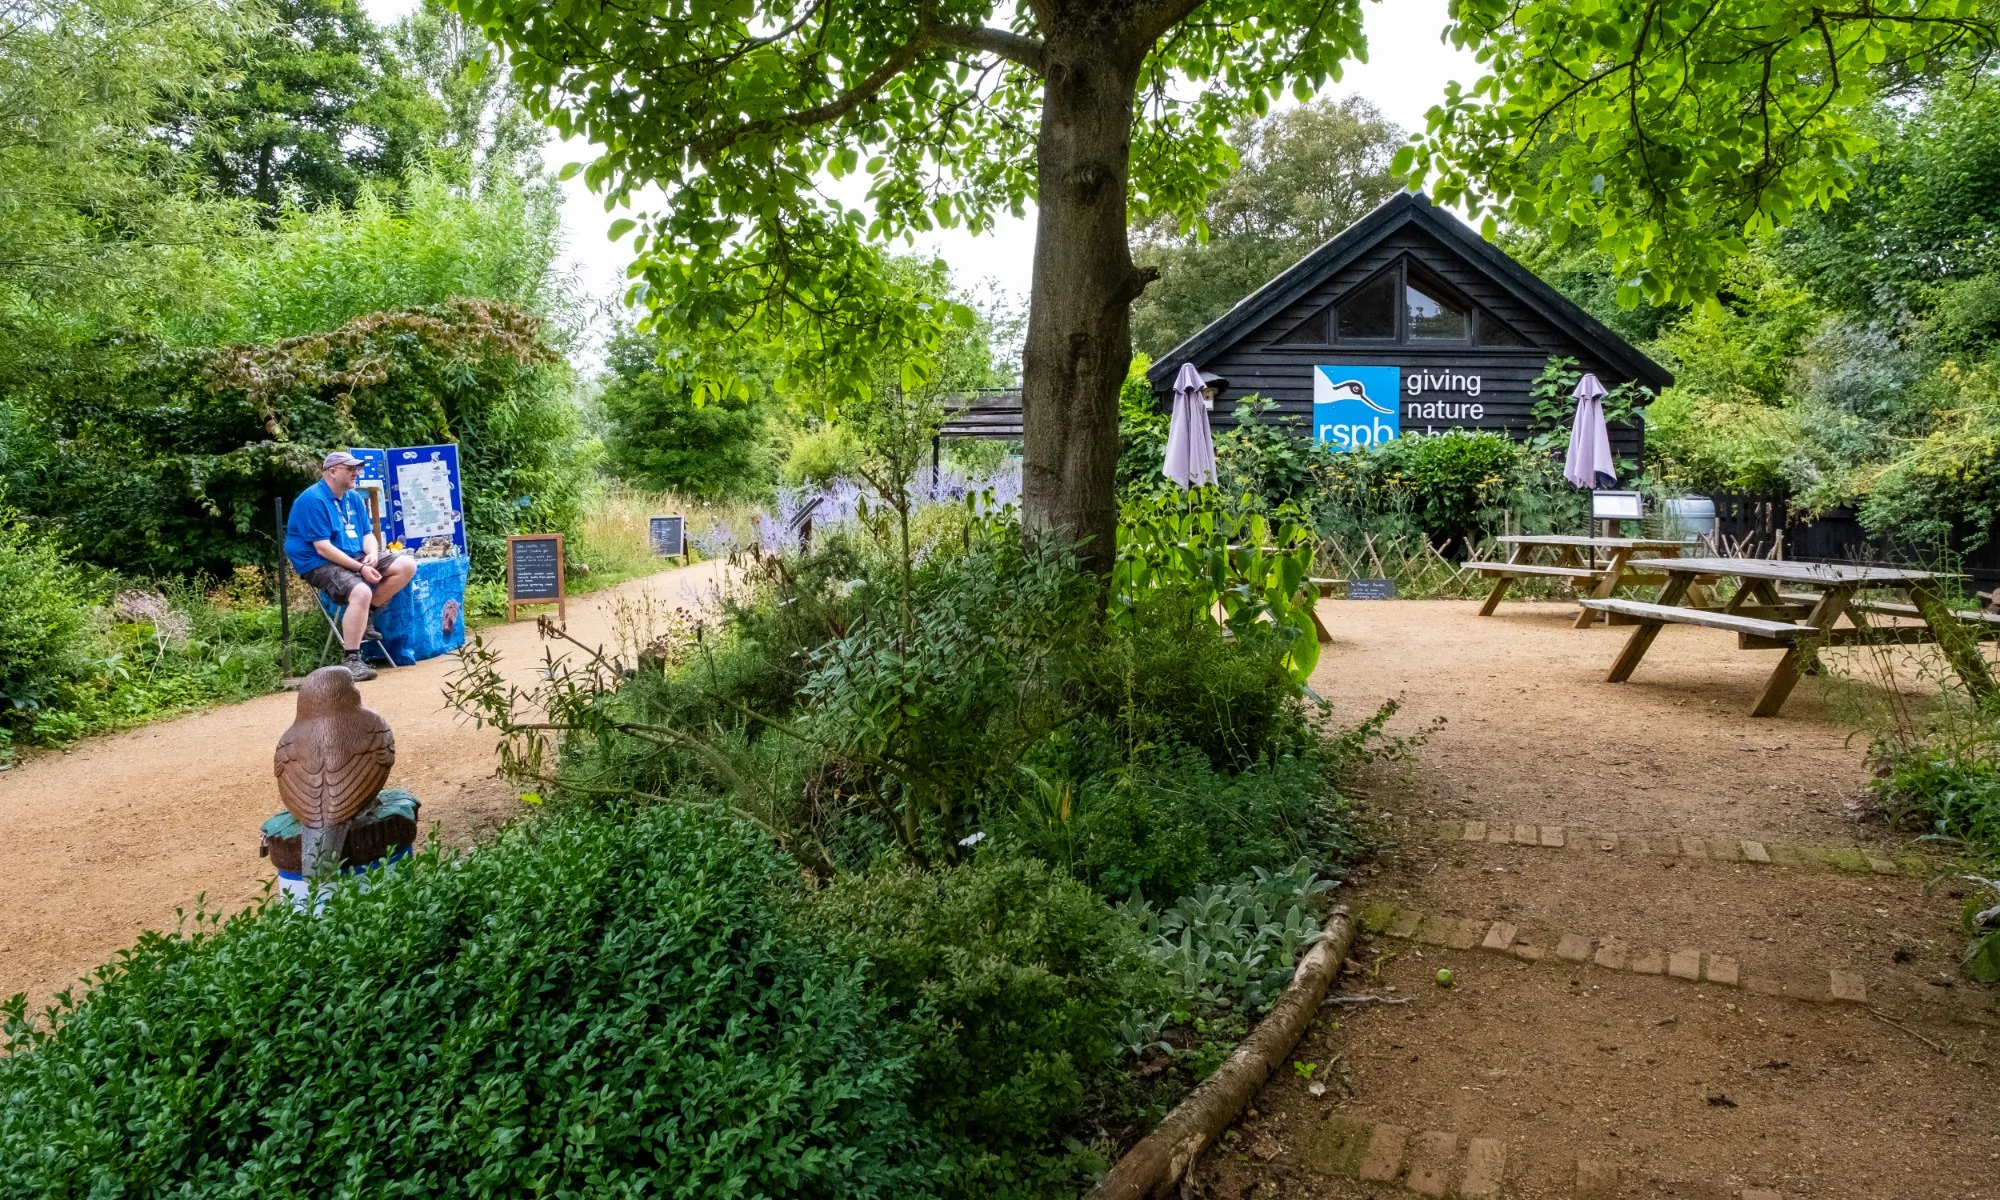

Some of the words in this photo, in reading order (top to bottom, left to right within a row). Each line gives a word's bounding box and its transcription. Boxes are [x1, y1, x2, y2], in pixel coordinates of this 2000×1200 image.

[1407, 369, 1481, 396] giving
[1407, 400, 1484, 420] nature
[1319, 416, 1394, 447] rspb
